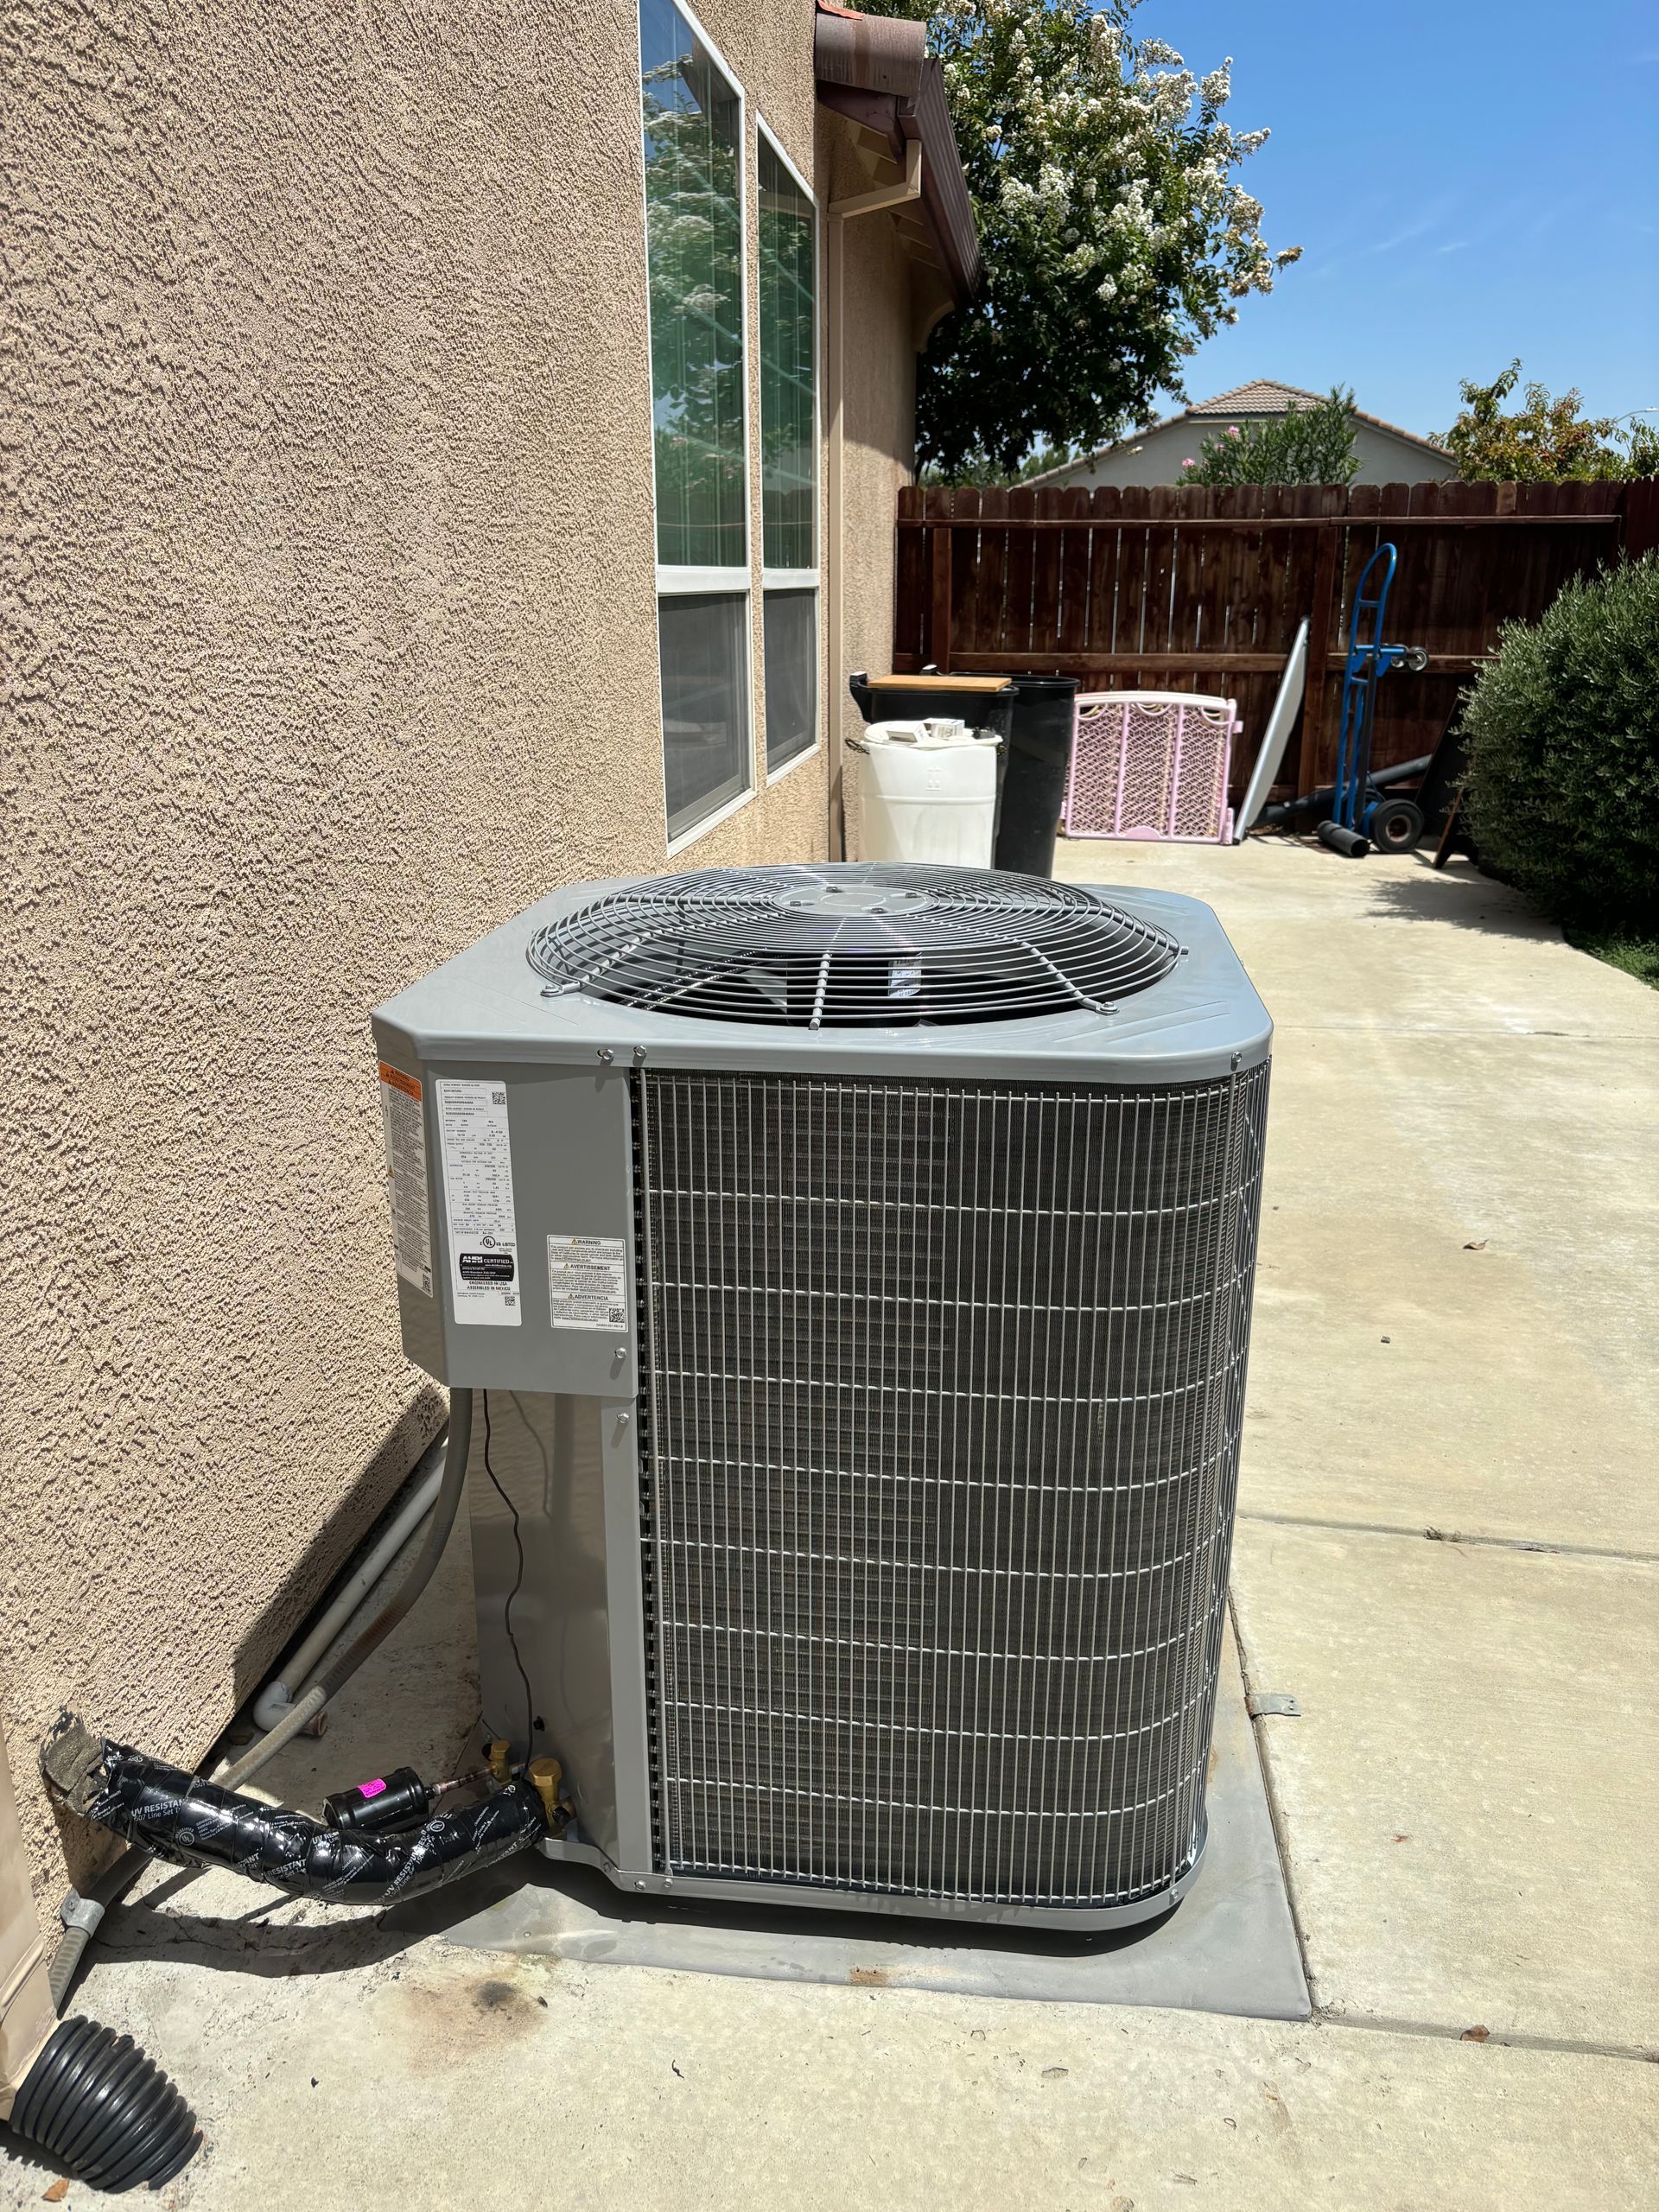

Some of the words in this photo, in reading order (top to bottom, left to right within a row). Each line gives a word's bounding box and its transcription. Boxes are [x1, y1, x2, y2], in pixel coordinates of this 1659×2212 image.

[131, 1805, 143, 1818] UV
[144, 1799, 185, 1813] RESISTAN
[147, 1811, 161, 1820] Line
[163, 1808, 174, 1818] Set
[385, 1885, 395, 1897] UV
